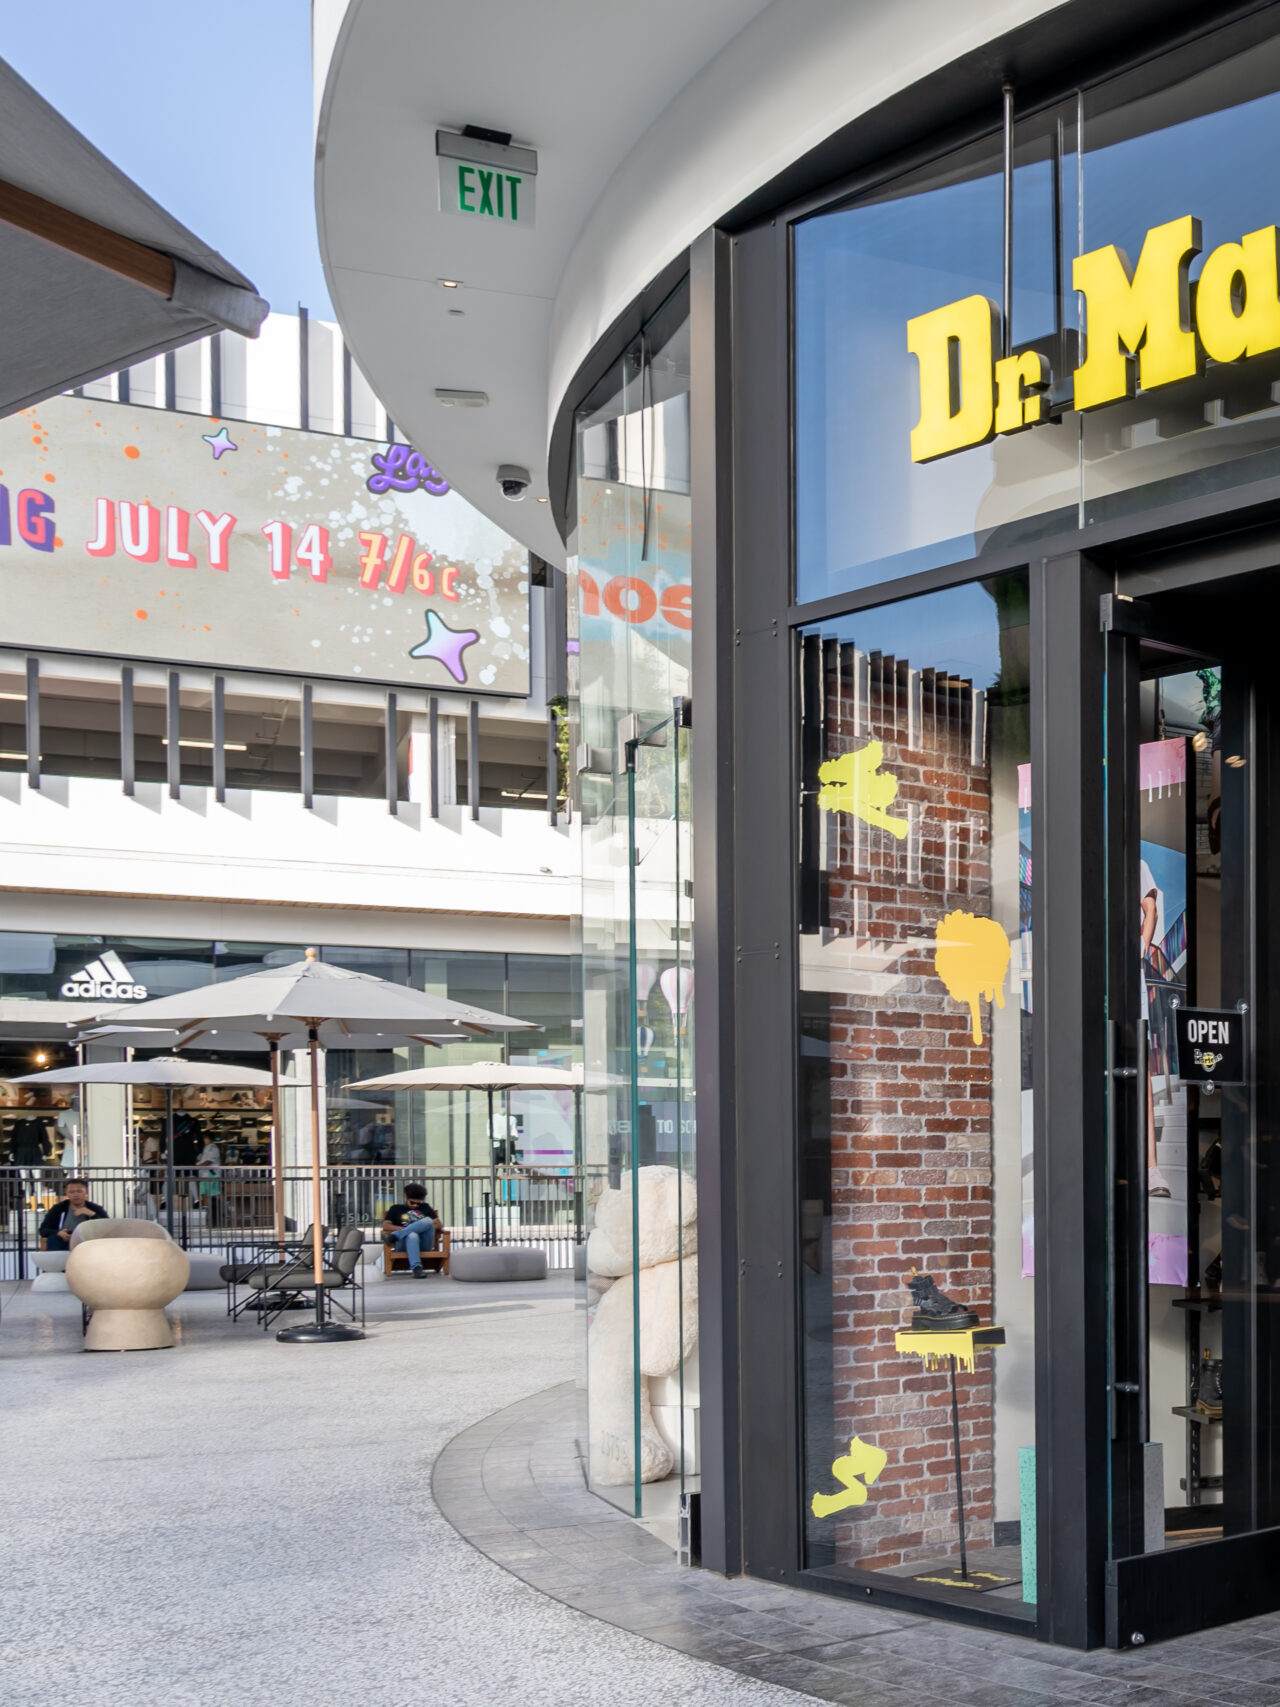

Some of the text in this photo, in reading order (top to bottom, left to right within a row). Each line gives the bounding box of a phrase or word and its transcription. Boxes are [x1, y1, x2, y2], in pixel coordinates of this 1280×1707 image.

[458, 165, 522, 221] EXIT
[0, 483, 55, 553] G
[85, 497, 237, 572] JULY
[261, 520, 333, 583] 14
[61, 980, 148, 1000] adidas
[1188, 1019, 1230, 1044] OPEN
